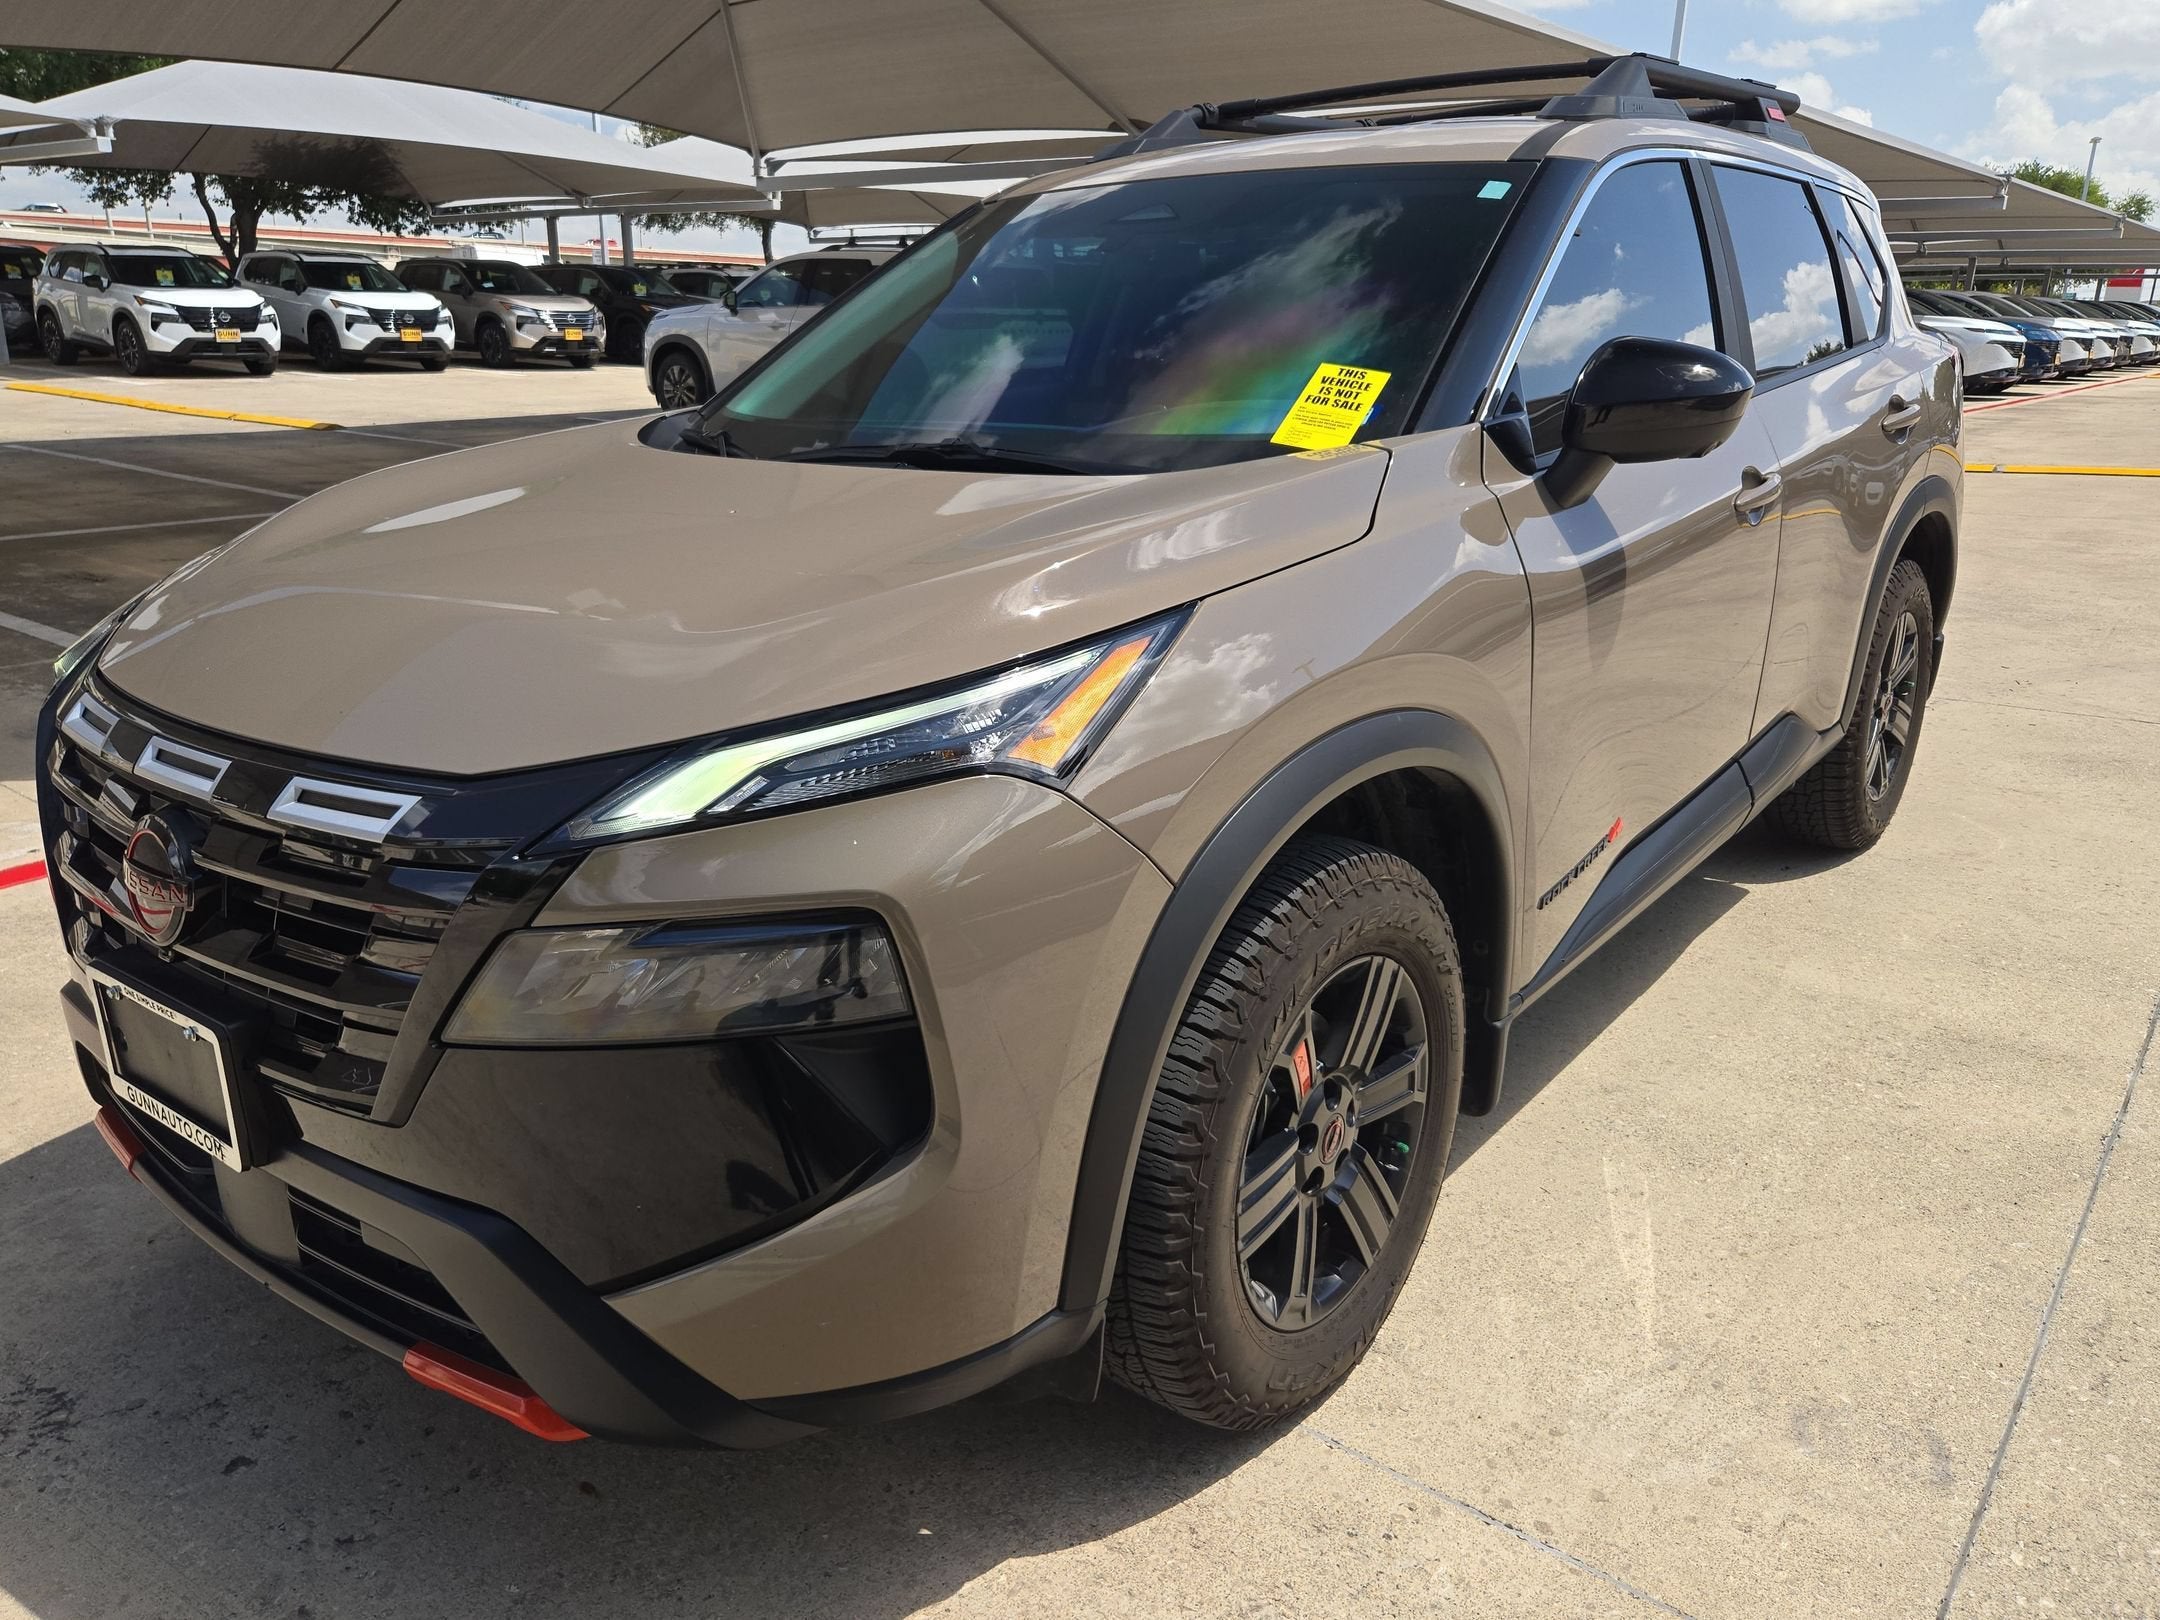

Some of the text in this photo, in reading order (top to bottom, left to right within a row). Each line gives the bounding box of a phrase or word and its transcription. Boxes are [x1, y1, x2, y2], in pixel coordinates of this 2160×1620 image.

[1337, 368, 1367, 379] THIS
[1320, 376, 1373, 391] VEHICLE
[1318, 386, 1362, 400] IS NOT
[1304, 394, 1330, 405] FOR
[1331, 399, 1363, 412] SALE
[127, 1086, 224, 1160] GUNNAUTO.COM
